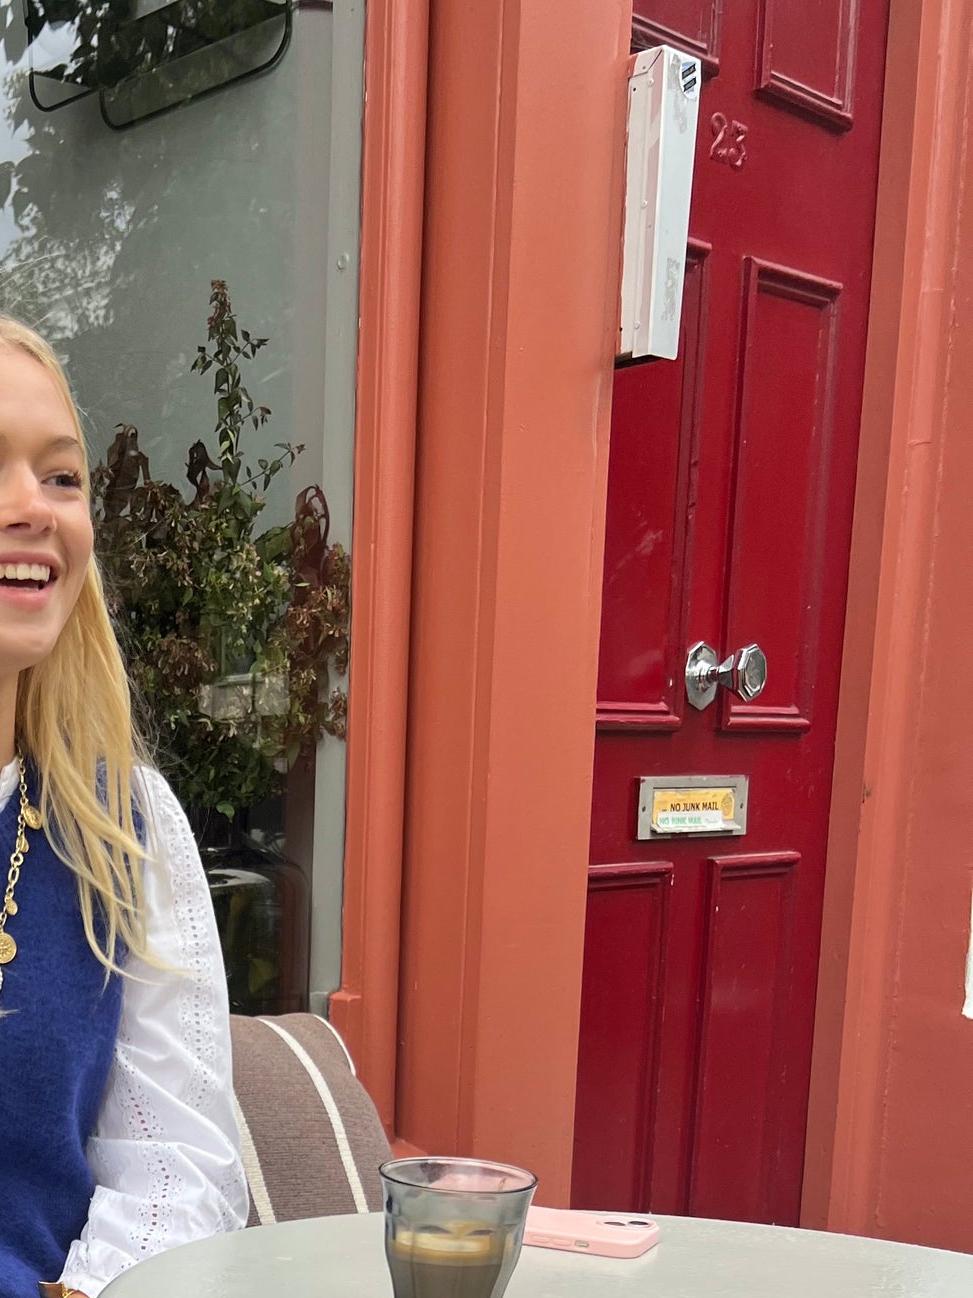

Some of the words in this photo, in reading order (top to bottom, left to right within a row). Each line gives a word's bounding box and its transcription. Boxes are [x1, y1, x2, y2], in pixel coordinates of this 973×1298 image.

[710, 111, 748, 168] 23
[670, 803, 680, 812] NO
[683, 802, 700, 811] JUNK
[702, 801, 719, 811] MAIL
